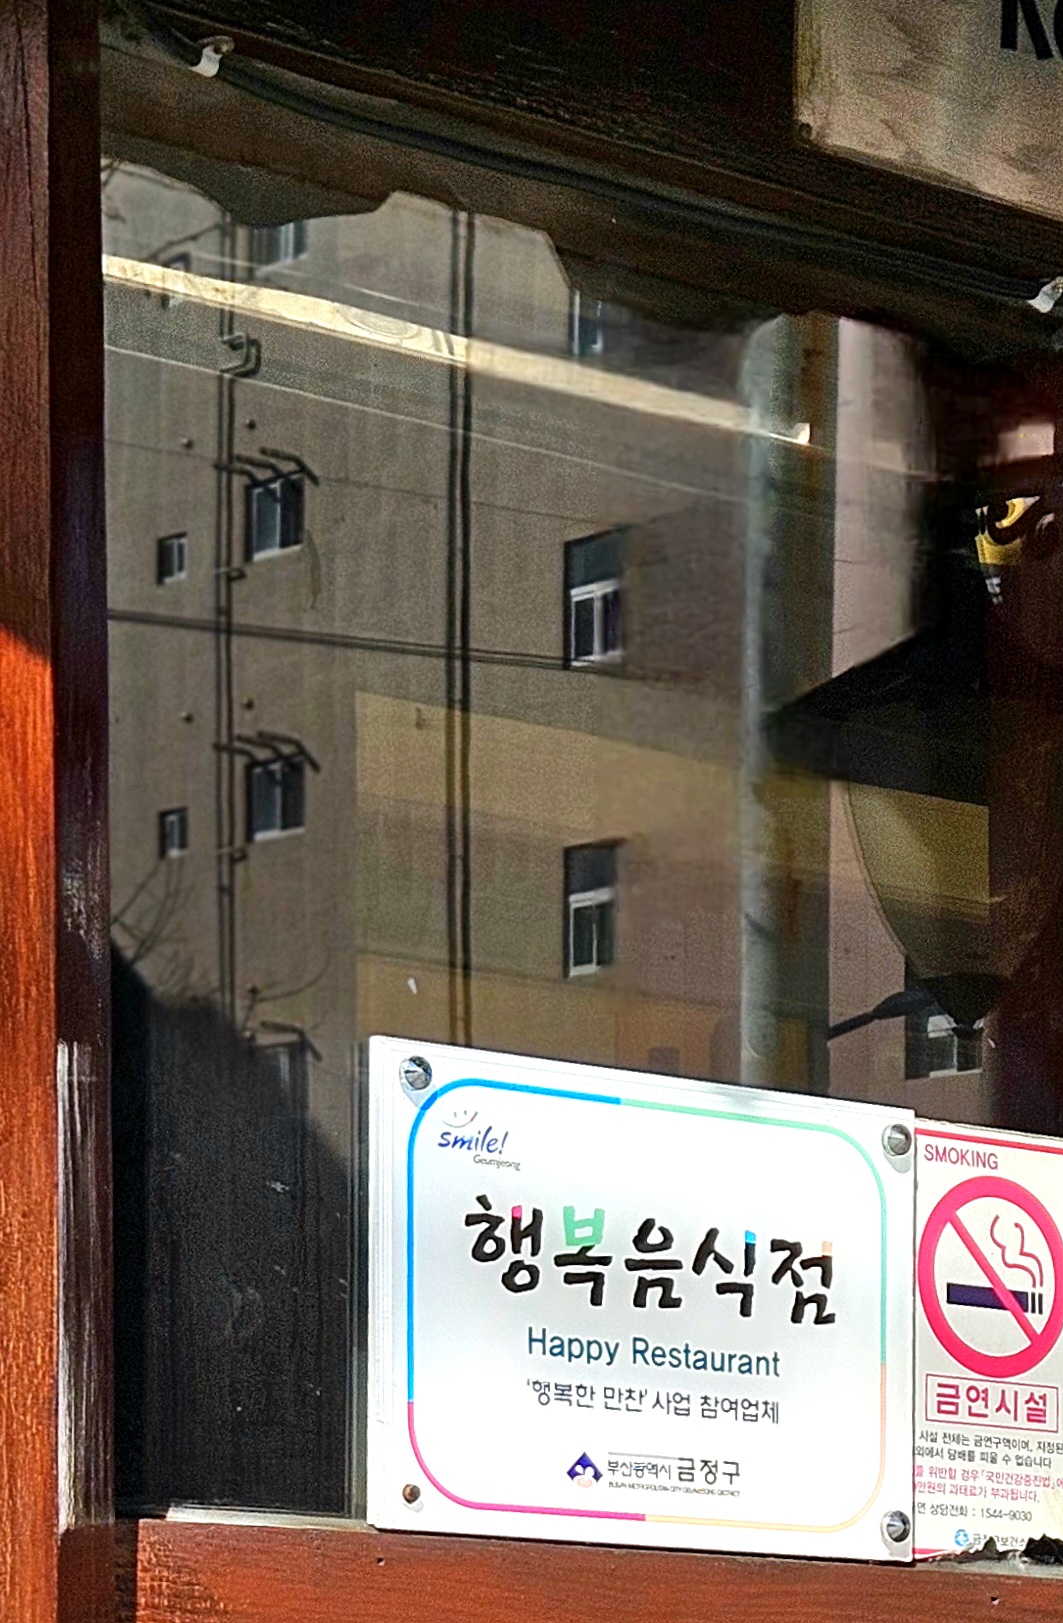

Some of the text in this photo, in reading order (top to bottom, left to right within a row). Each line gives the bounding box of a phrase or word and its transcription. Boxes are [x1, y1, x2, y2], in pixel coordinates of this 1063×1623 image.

[438, 1126, 508, 1154] smile!
[924, 1144, 999, 1170] SMOKING
[465, 1194, 836, 1325] 행복음식점
[527, 1326, 780, 1377] Happy Restaurant
[652, 1391, 691, 1417] 사업
[700, 1395, 780, 1424] 참여업체
[936, 1382, 1048, 1424] 금연시설
[919, 1430, 938, 1443] 시설
[942, 1432, 970, 1446] 전체는
[1036, 1441, 1063, 1455] 지정된
[607, 1457, 741, 1485] 부산광역시 금정구
[948, 1448, 975, 1462] 담배를
[980, 1451, 998, 1464] 피울
[1002, 1453, 1012, 1466] 수
[1015, 1454, 1052, 1469] 없습니다
[929, 1466, 957, 1480] 위반할
[961, 1469, 980, 1482] 경우
[930, 1503, 968, 1517] 상담전화
[981, 1507, 1033, 1521] 1544-9030
